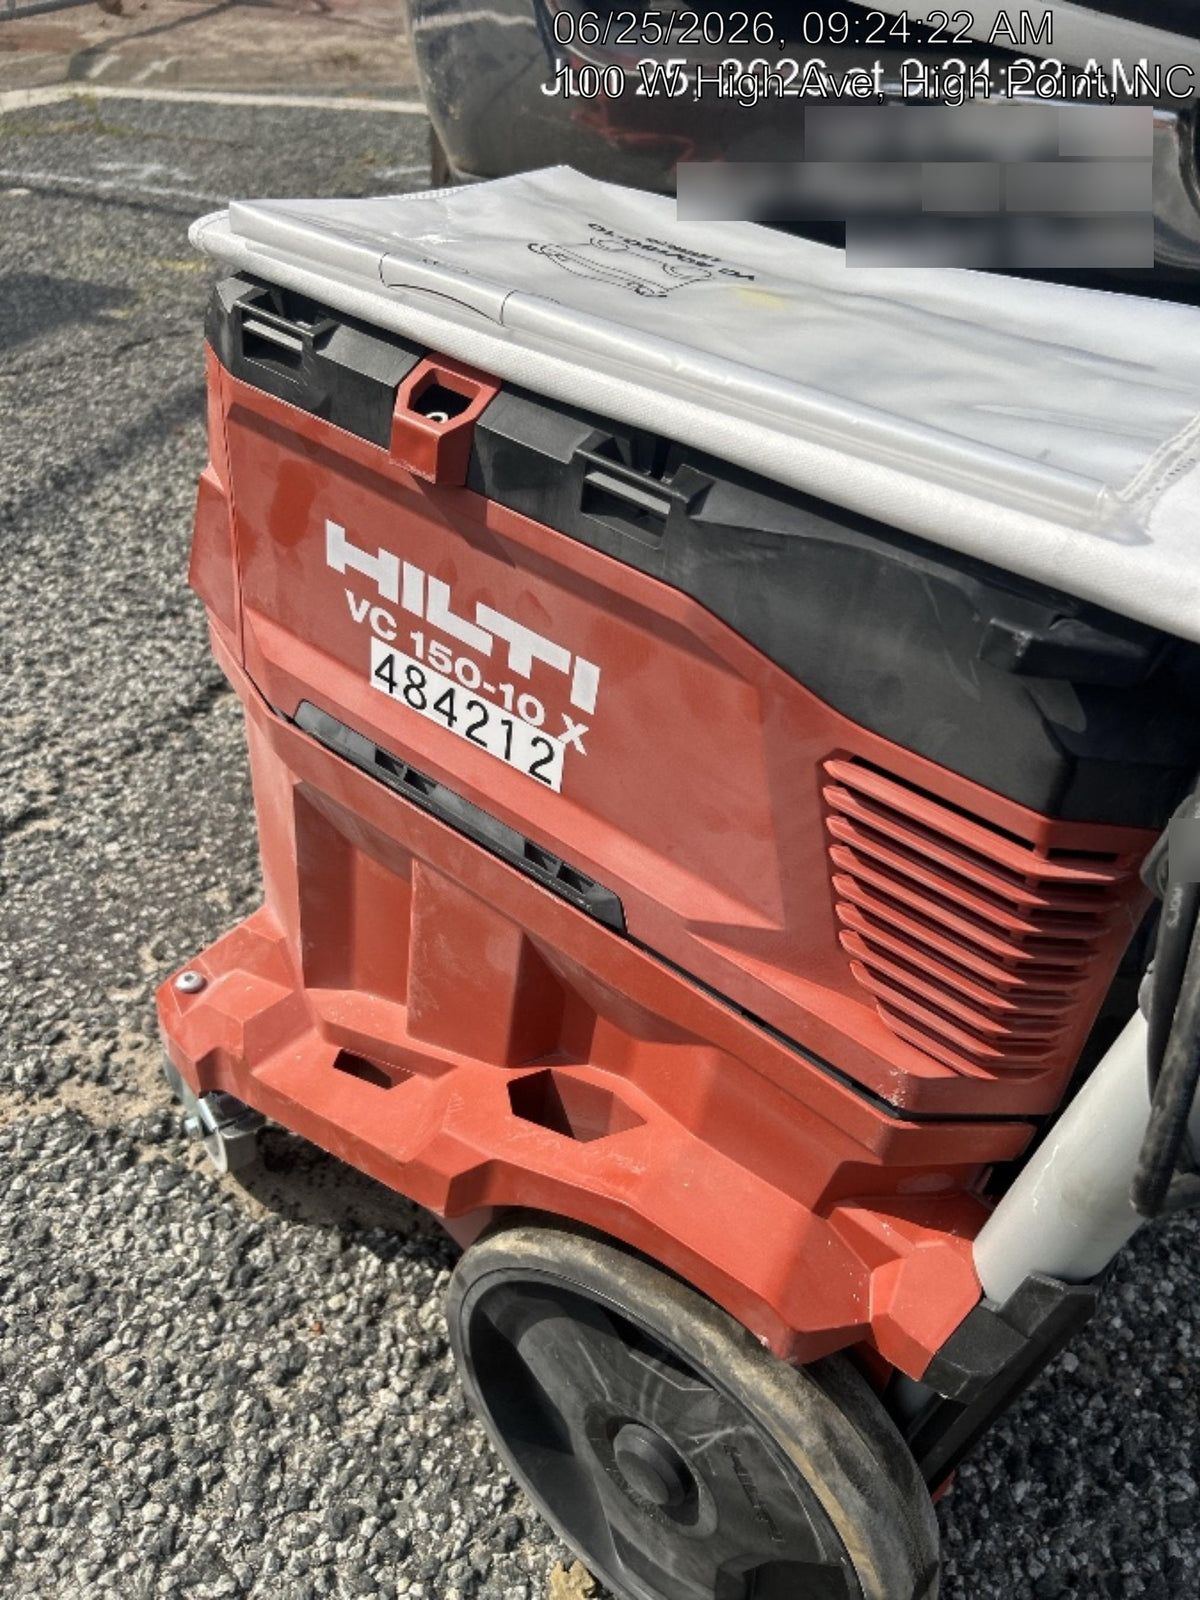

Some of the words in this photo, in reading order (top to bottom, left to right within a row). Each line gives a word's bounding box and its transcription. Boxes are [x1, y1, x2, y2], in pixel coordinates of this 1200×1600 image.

[325, 518, 601, 715] HILTI
[344, 587, 398, 642] VC
[409, 630, 546, 727] 150-10
[557, 712, 590, 757] X
[373, 653, 555, 786] 484212
